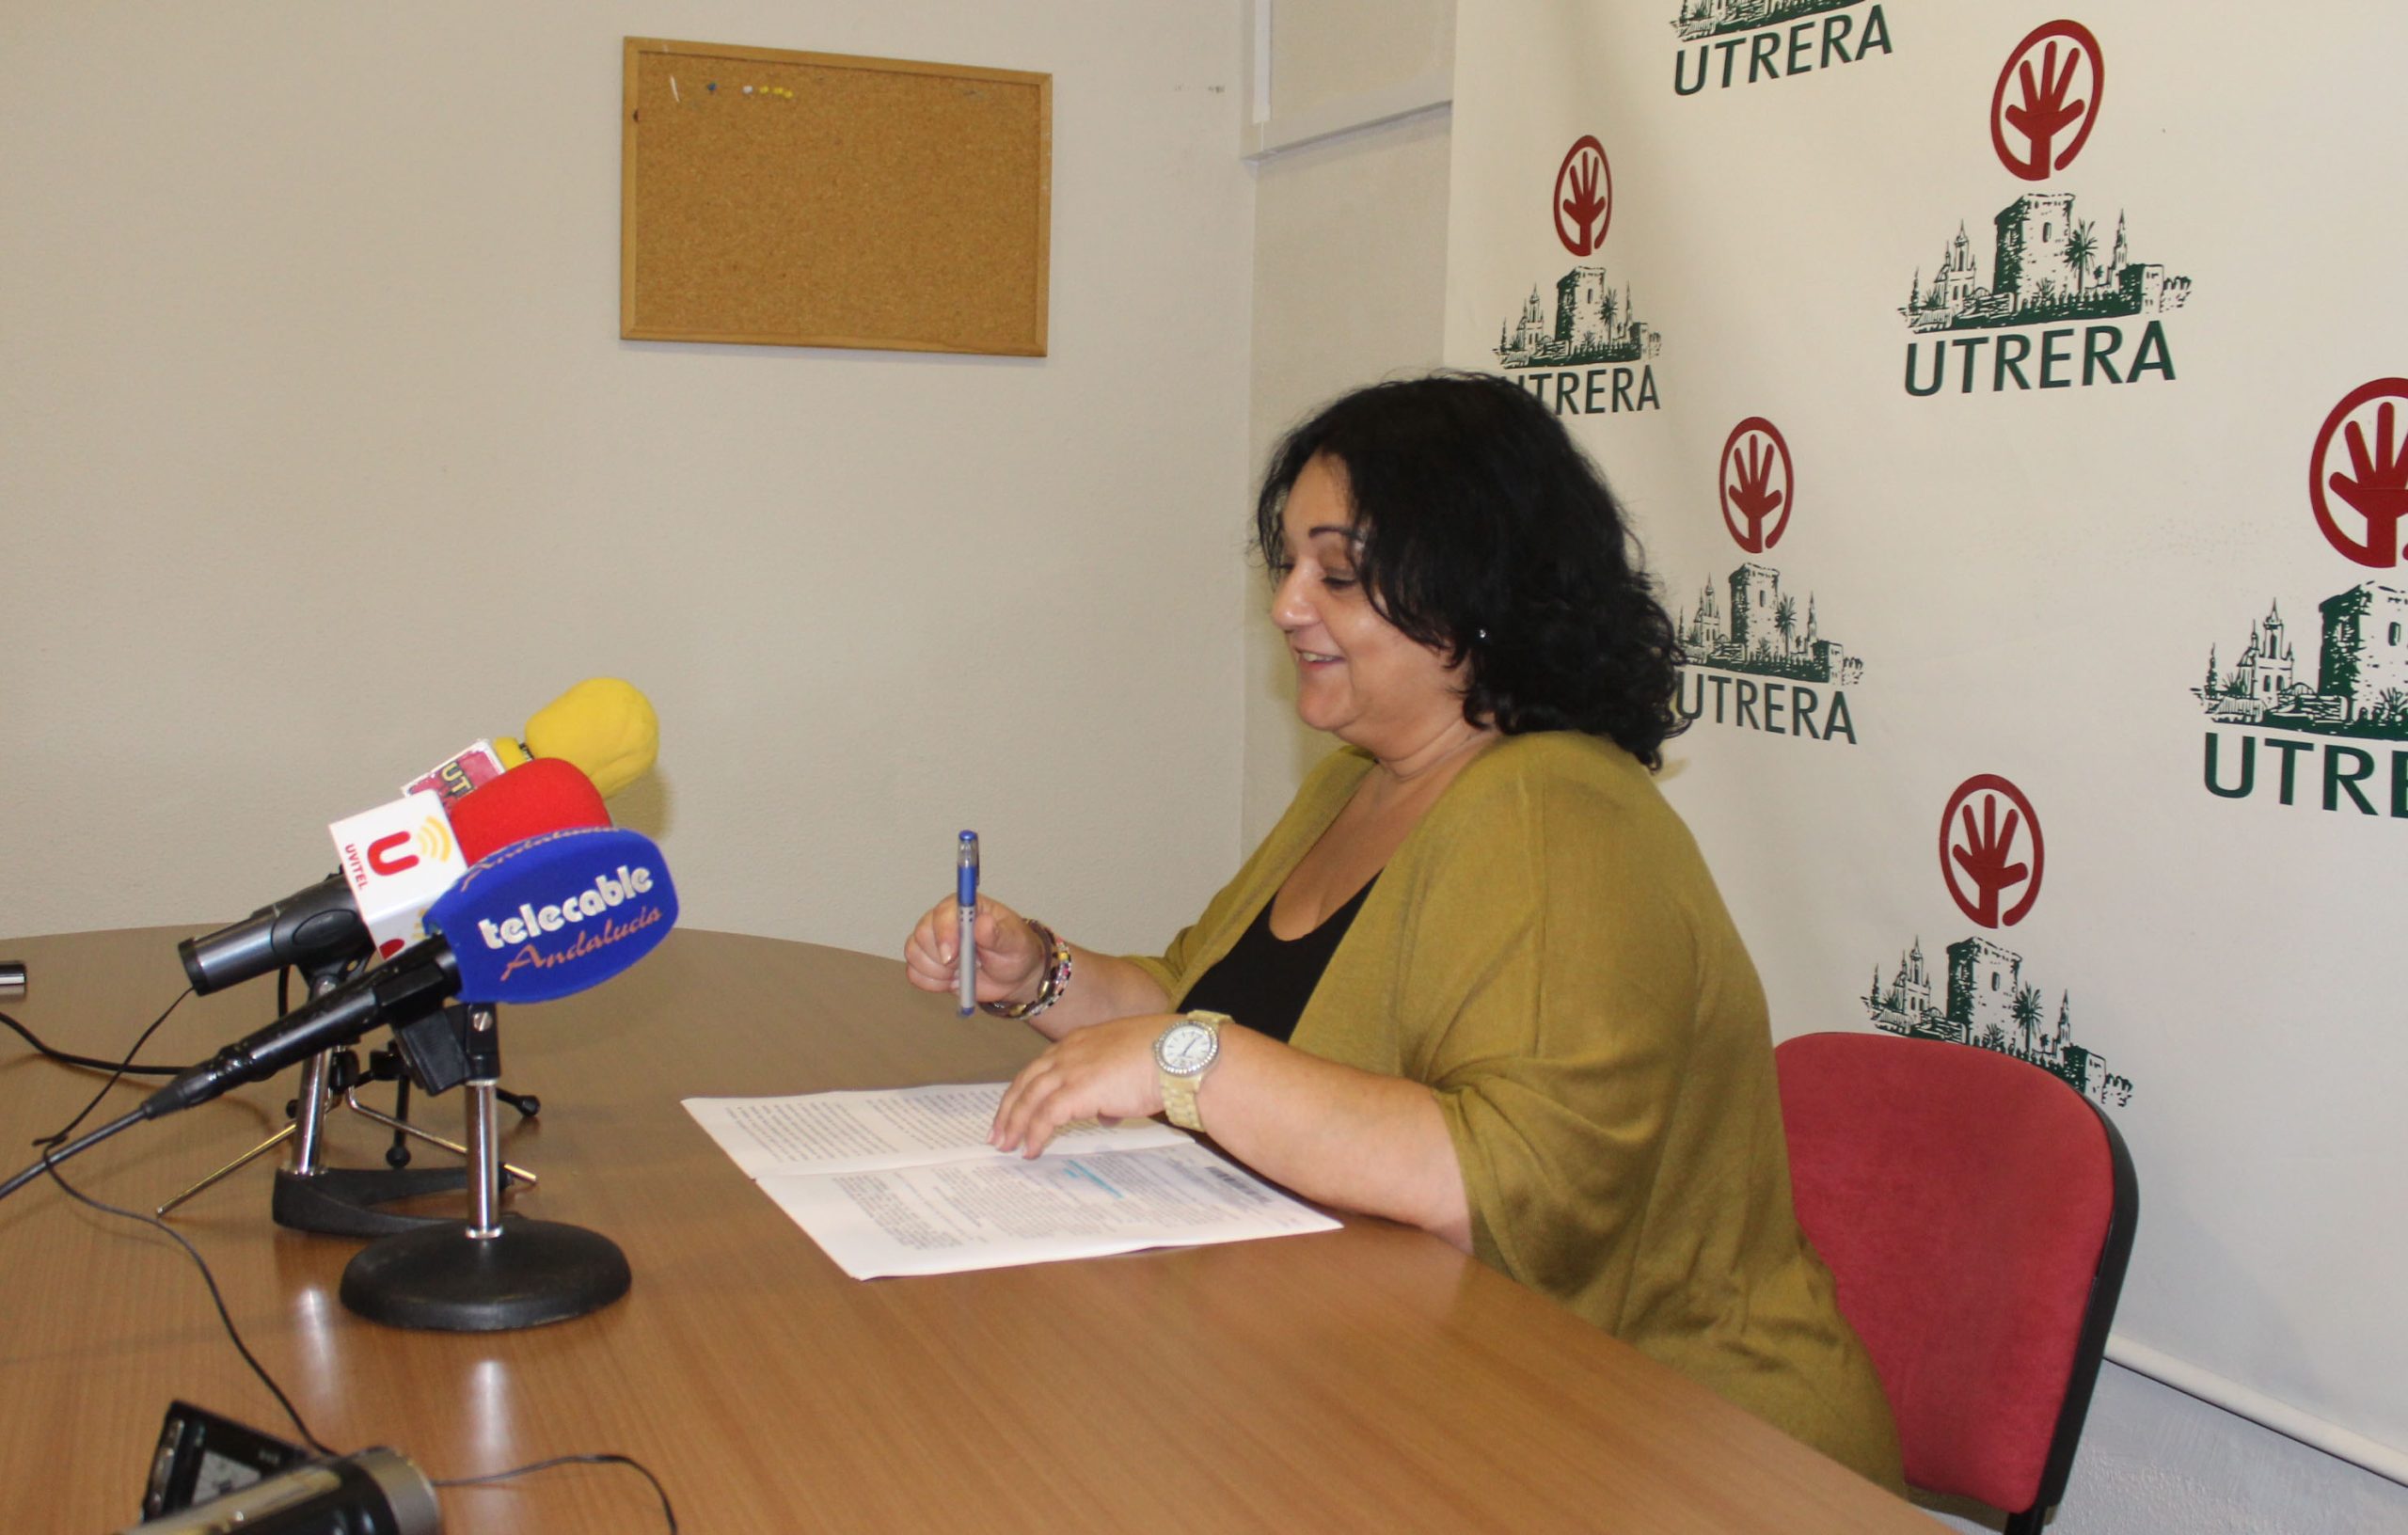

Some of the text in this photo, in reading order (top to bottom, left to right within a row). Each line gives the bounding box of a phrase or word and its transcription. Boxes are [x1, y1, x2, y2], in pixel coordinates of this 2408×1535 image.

[1674, 4, 1893, 96] UTRERA
[1516, 364, 1660, 416] TRERA
[1905, 320, 2177, 397] UTRERA
[1675, 671, 1857, 745] UTRERA
[344, 843, 368, 890] UVITEL
[367, 831, 420, 876] U
[478, 865, 654, 950] telecable
